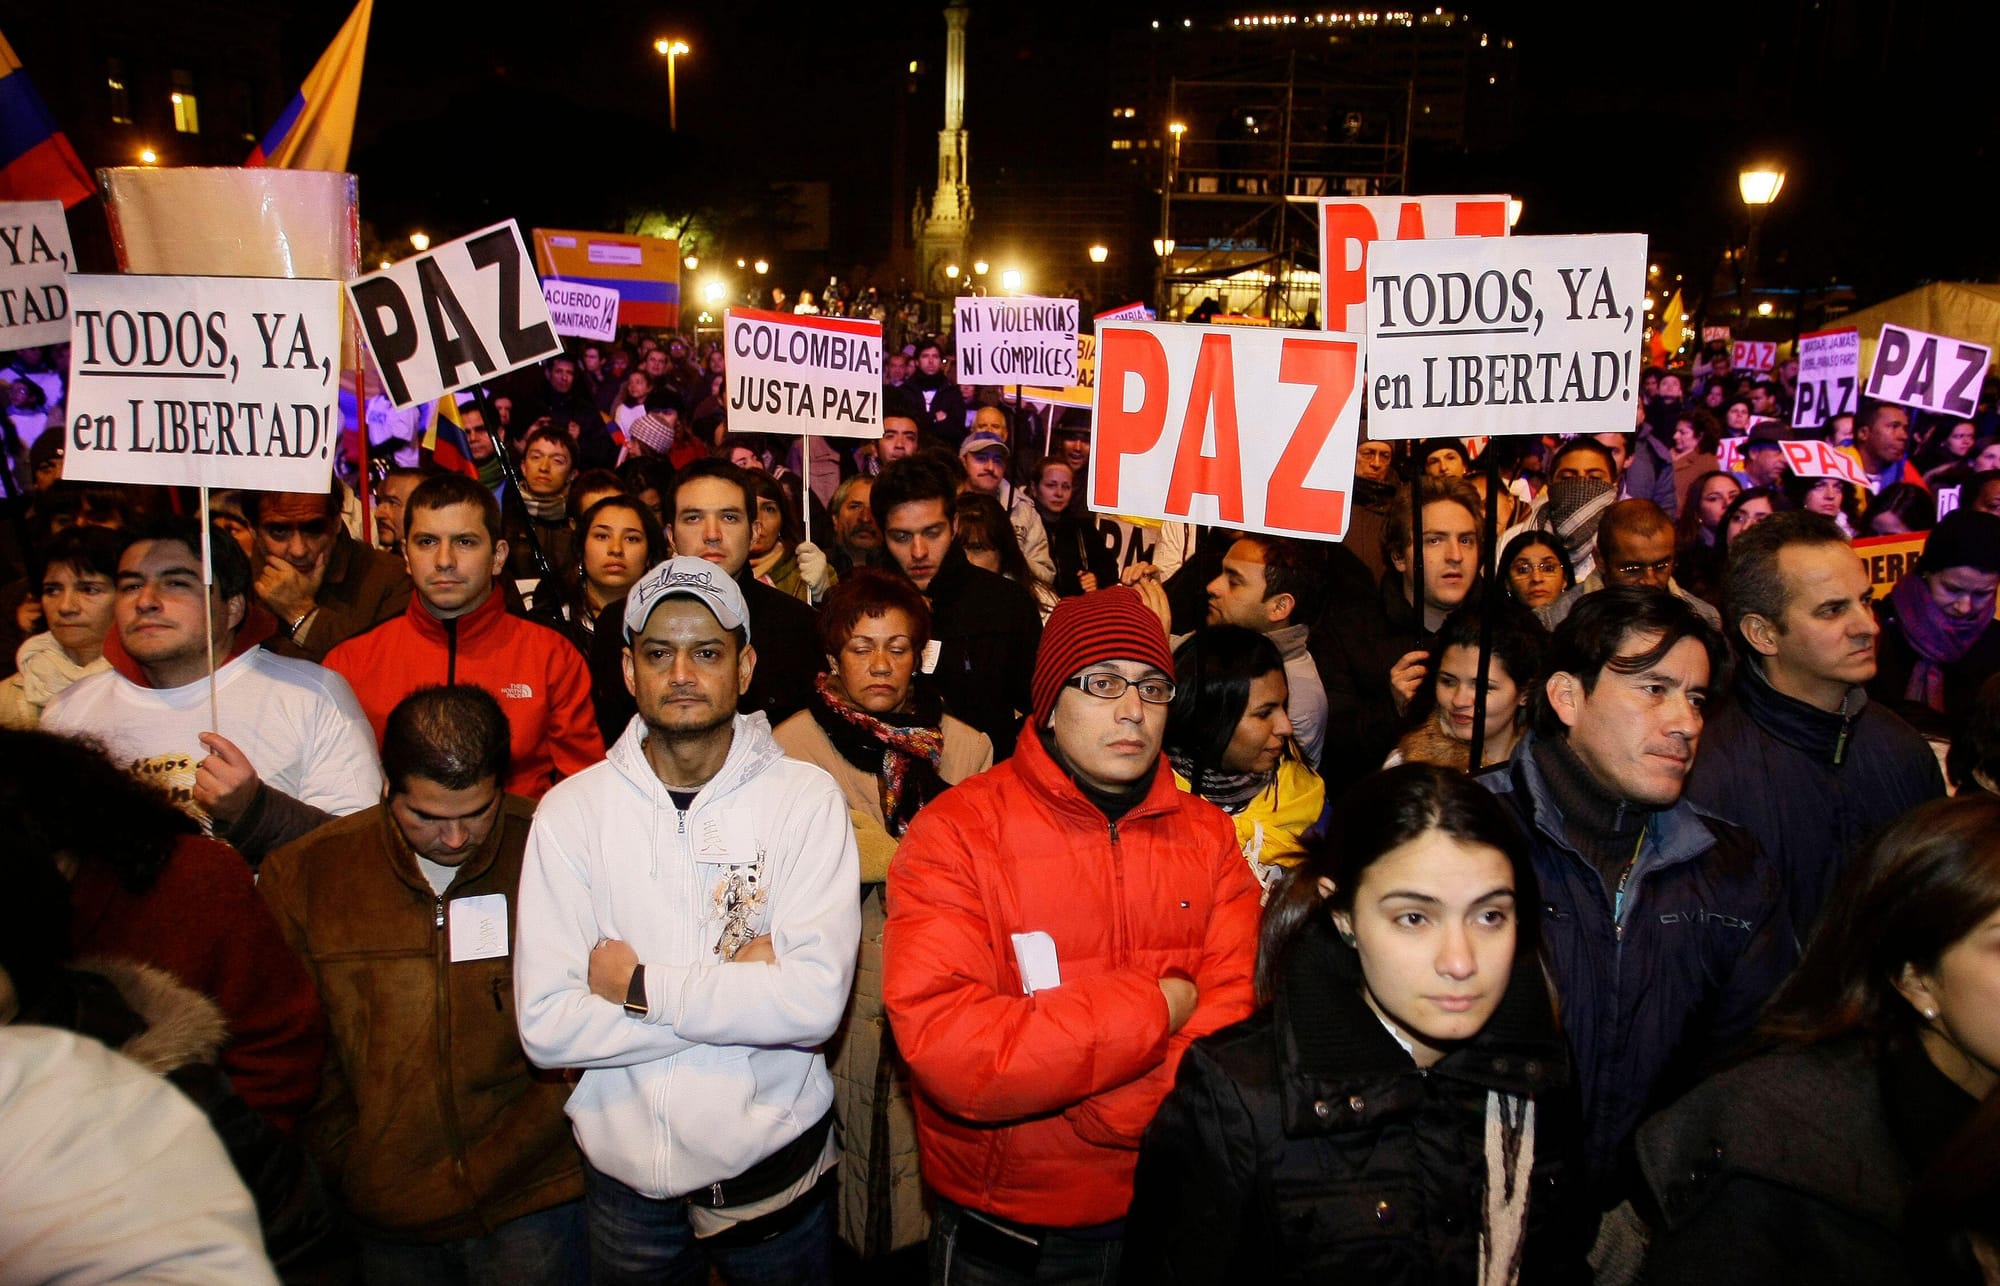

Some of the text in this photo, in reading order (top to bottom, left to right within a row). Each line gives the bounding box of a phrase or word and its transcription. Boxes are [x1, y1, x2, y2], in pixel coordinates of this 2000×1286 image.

[0, 224, 68, 272] YA,
[0, 284, 68, 328] TAD
[351, 226, 556, 406] PAZ
[545, 290, 600, 309] ACUERDO
[1373, 266, 1634, 336] TODOS, YA,
[75, 310, 332, 387] TODOS, YA,
[733, 323, 880, 374] COLOMBIA:
[1734, 342, 1775, 369] PAZ
[1869, 328, 1987, 413] PAZ
[731, 375, 877, 424] JUSTA PAZ!
[1374, 349, 1632, 410] en LIBERTAD!
[1795, 376, 1855, 424] PAZ
[74, 398, 331, 461] en LIBERTAD!
[1094, 328, 1357, 535] PAZ
[1716, 437, 1749, 470] PA
[1783, 442, 1870, 486] PAZ
